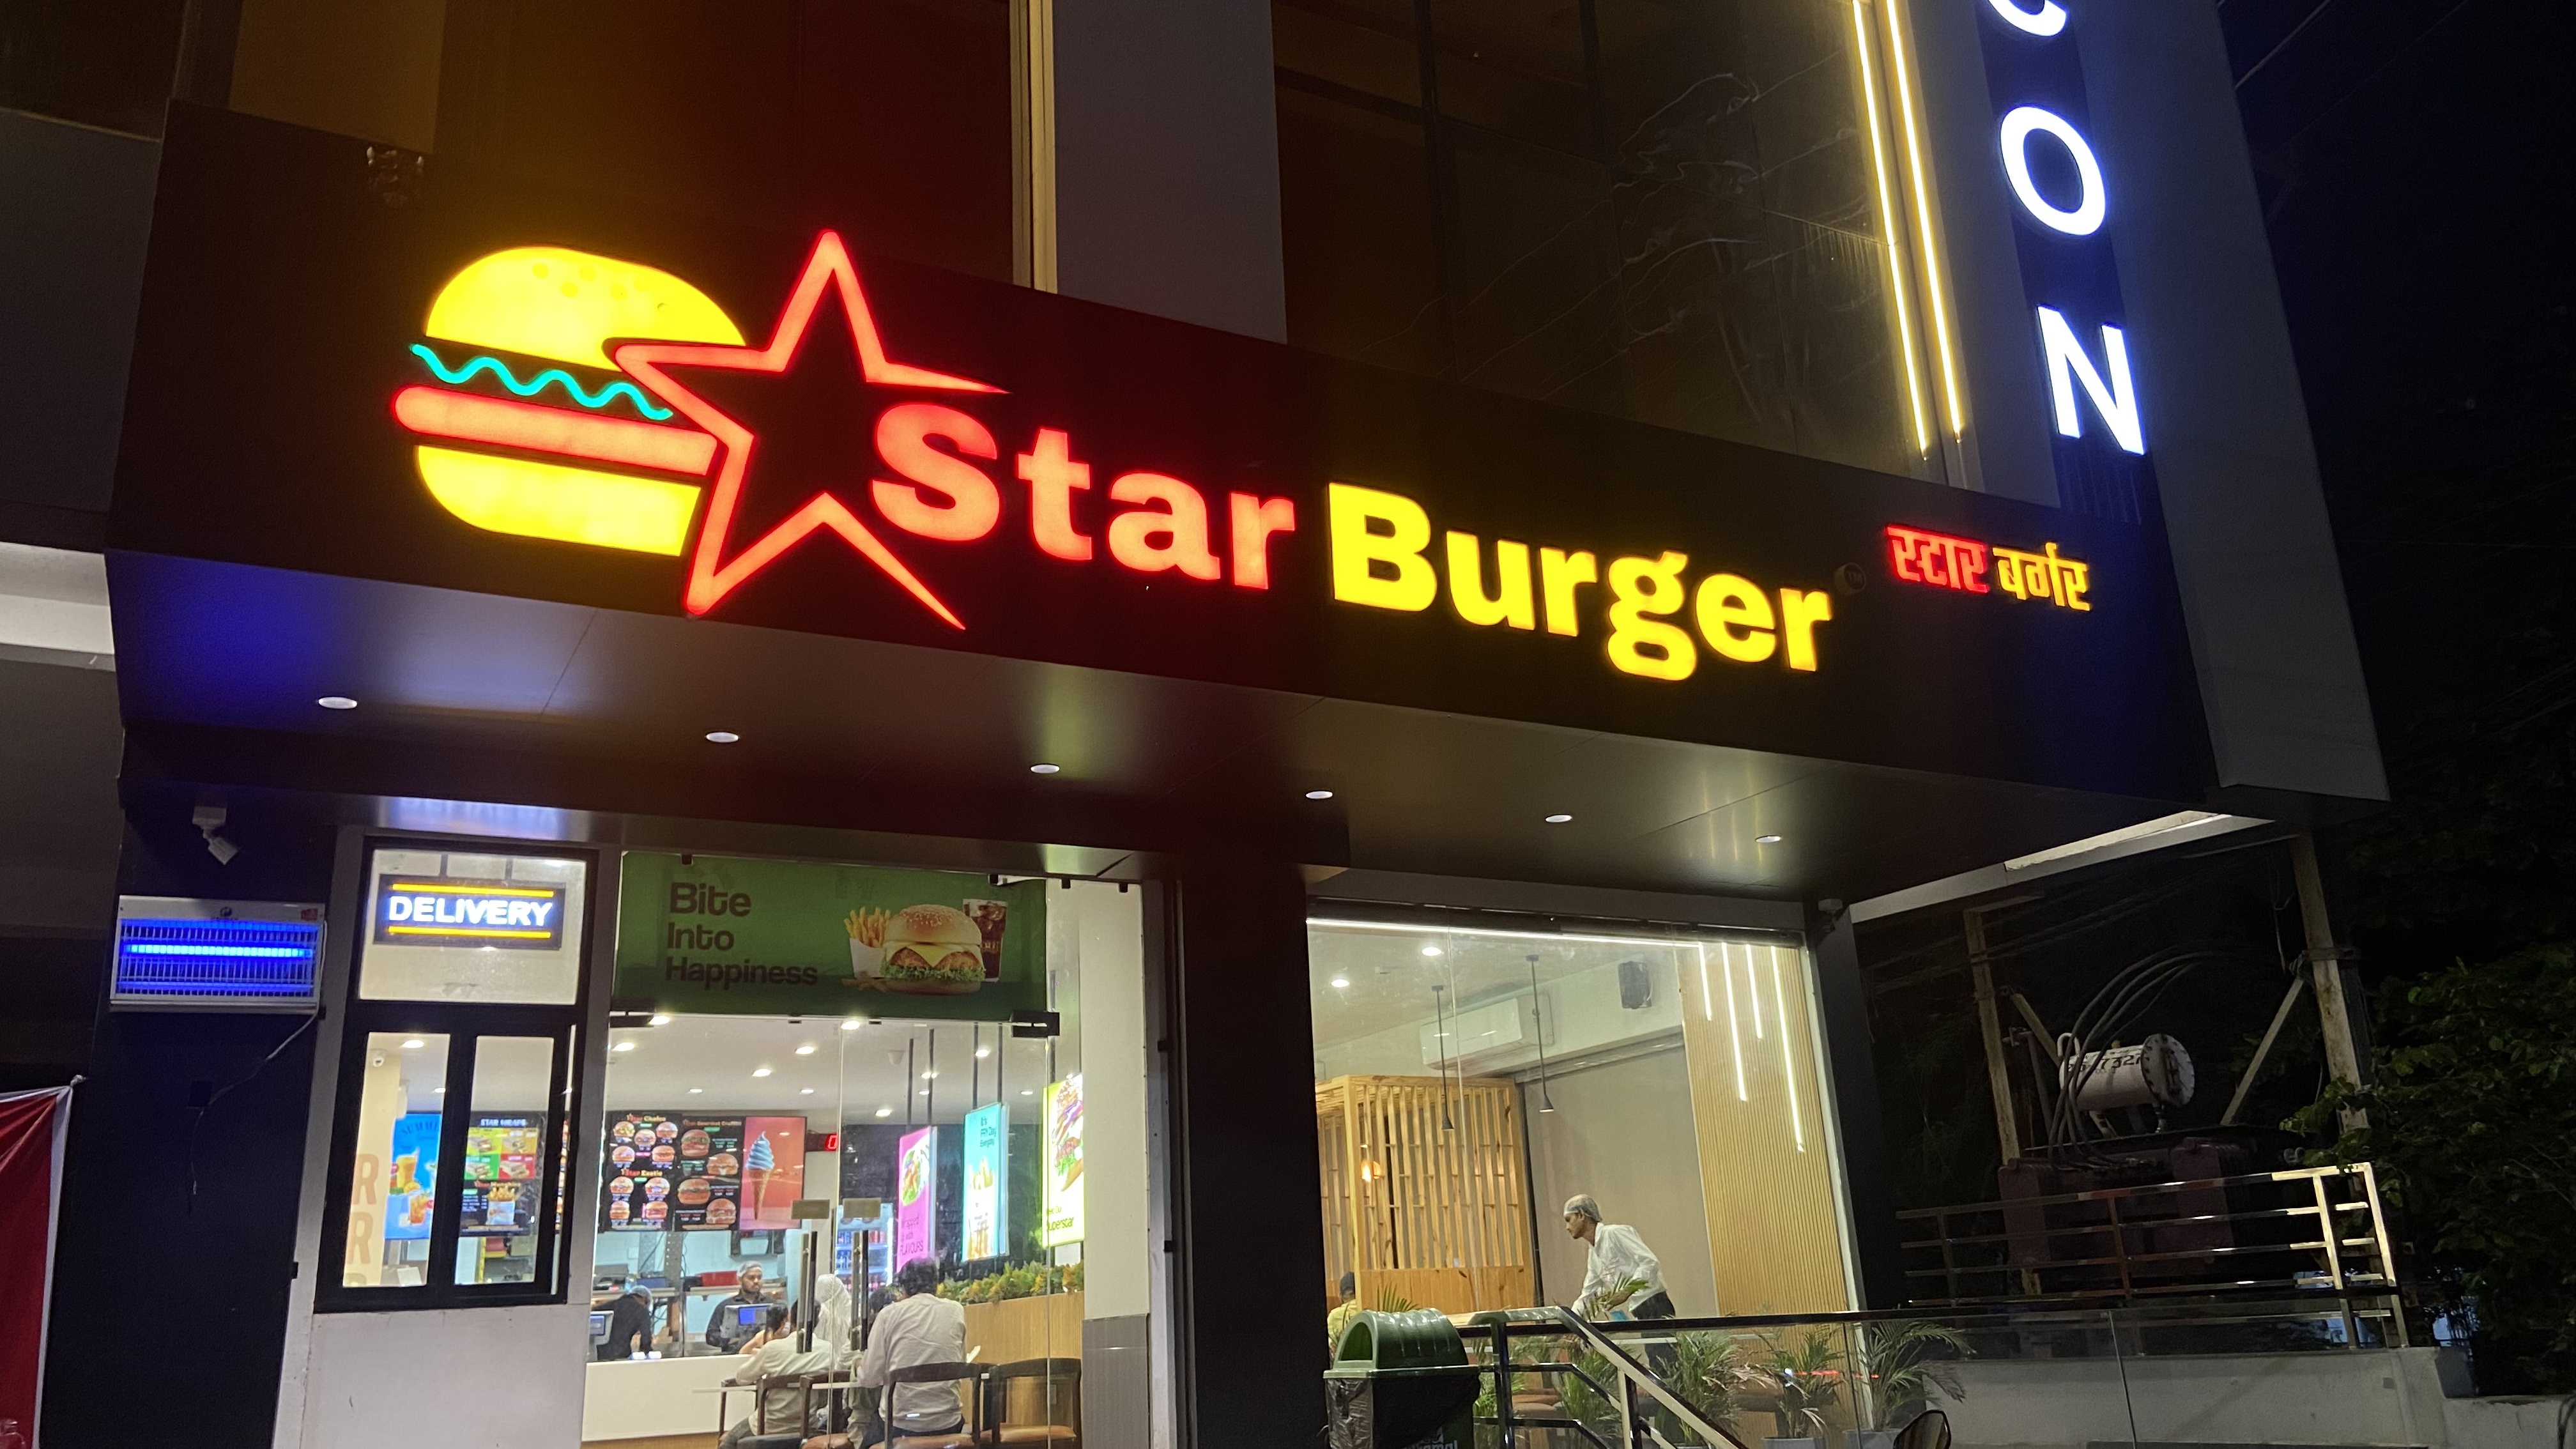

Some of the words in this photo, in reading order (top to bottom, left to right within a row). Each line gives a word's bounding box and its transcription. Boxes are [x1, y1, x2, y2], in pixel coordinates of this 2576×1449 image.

[1988, 0, 2145, 456] ON
[871, 402, 1296, 590] Star
[1327, 481, 1832, 682] Burger
[1885, 525, 1989, 594] स्टार
[1991, 542, 2091, 611] बर्गर
[388, 895, 553, 926] DELIVERY
[669, 882, 752, 917] Bite
[666, 921, 735, 952] Into
[664, 956, 818, 991] Happiness
[480, 1118, 498, 1126] STAR
